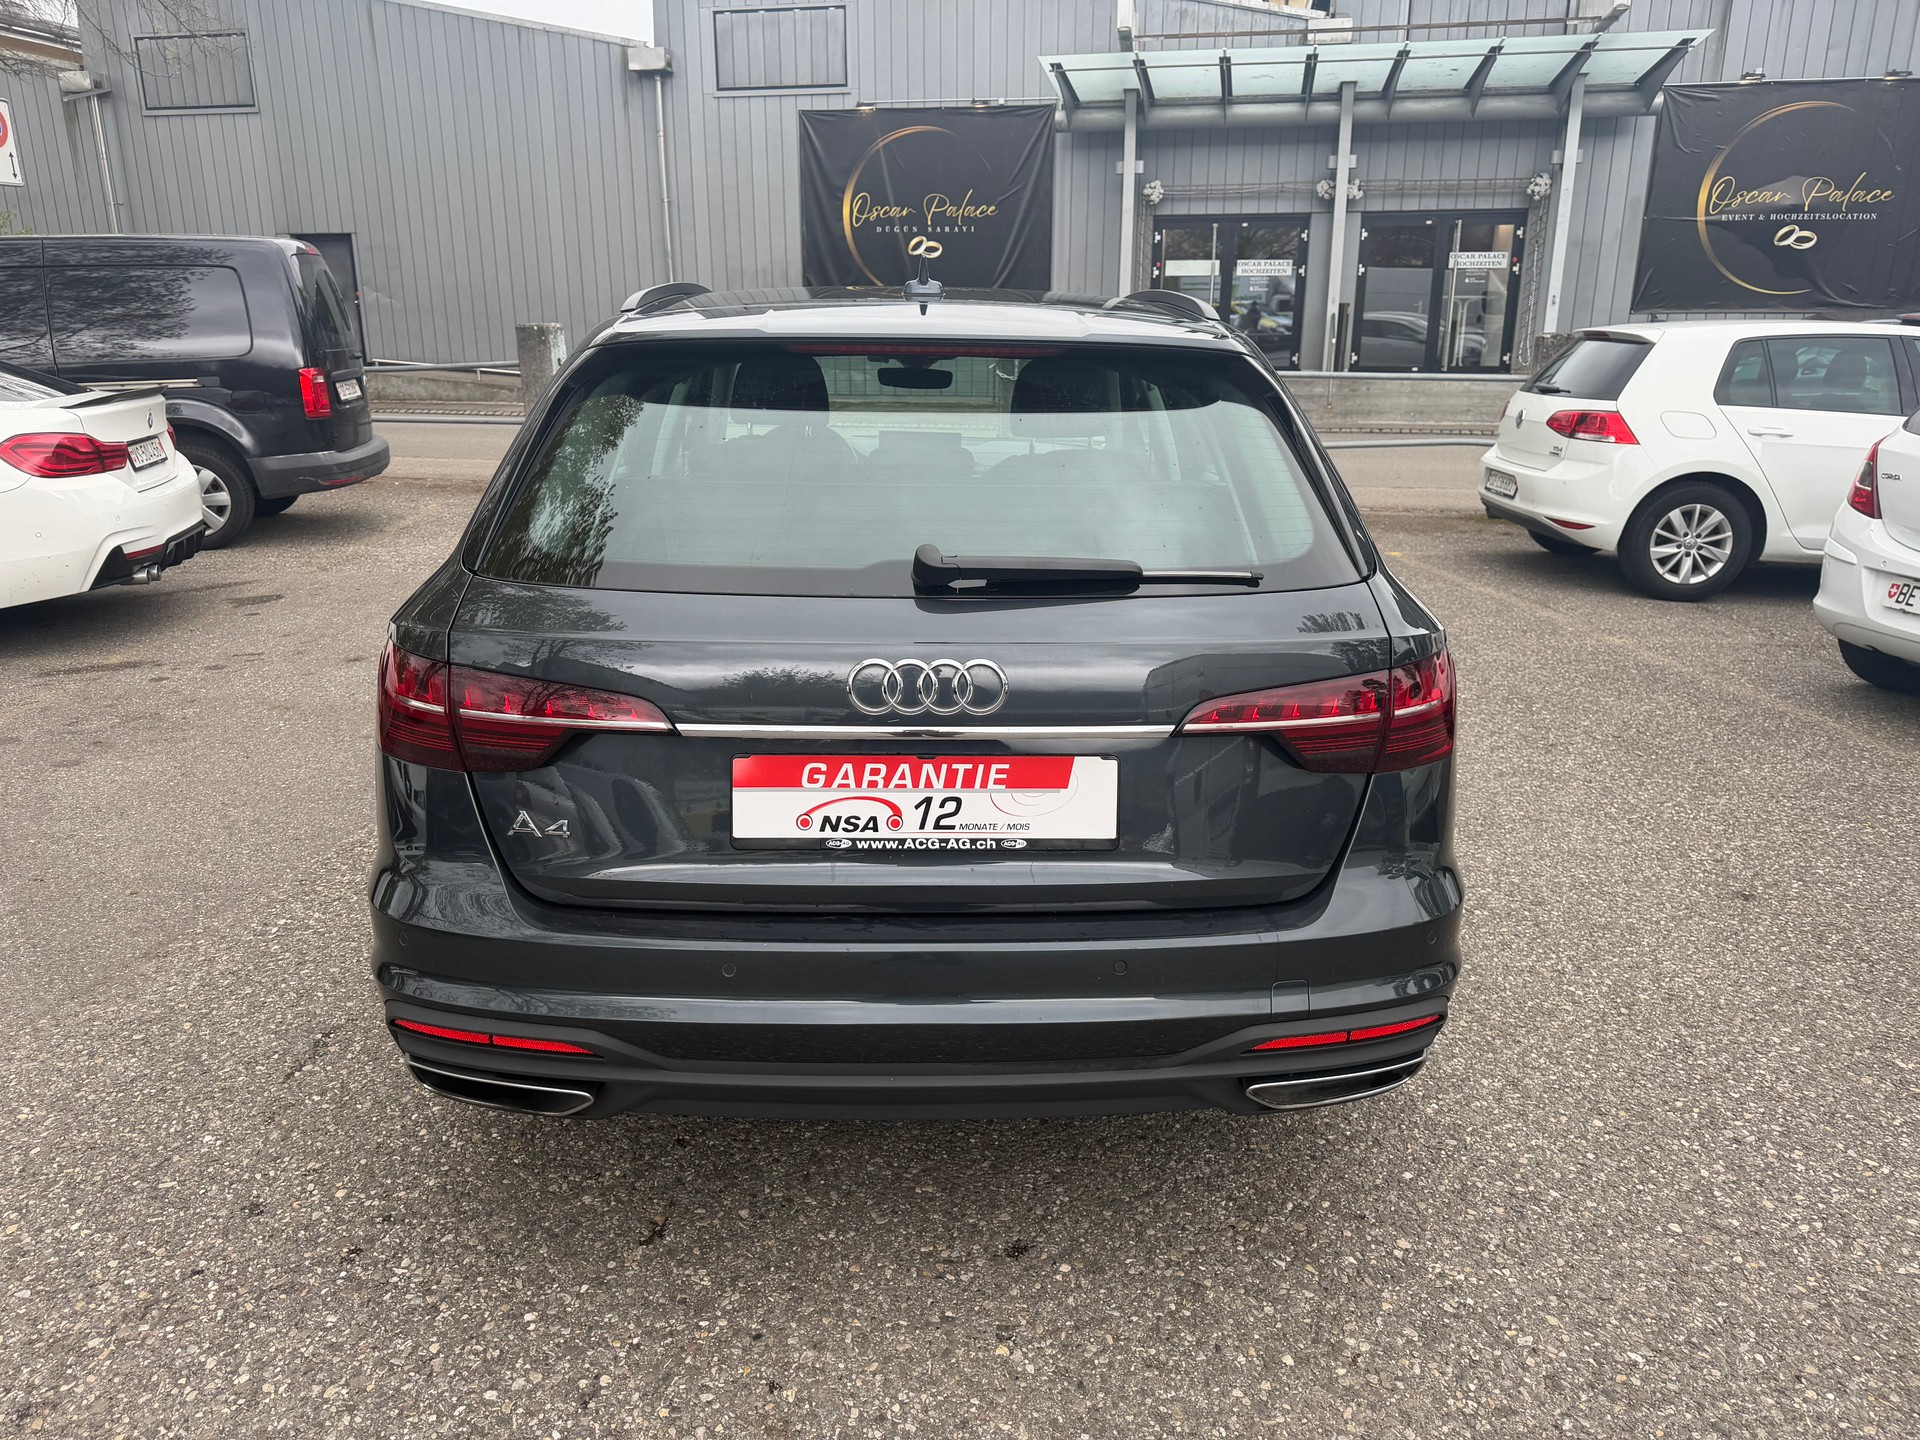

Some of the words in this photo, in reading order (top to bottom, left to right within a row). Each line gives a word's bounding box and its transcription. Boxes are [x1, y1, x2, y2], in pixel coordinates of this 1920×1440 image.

[1709, 176, 1792, 214] Oscar
[1802, 171, 1895, 212] Palace
[852, 192, 916, 227] Oscar
[923, 189, 998, 226] Palace
[1721, 213, 1755, 221] EVENT
[1758, 213, 1766, 221] &
[1770, 212, 1878, 221] HOCHZEITSLOCATION
[928, 225, 976, 233] SARAYI
[1895, 583, 1920, 607] BE
[801, 763, 1010, 789] GARANTIE
[507, 810, 571, 838] A4
[819, 815, 879, 833] NSA
[914, 796, 963, 830] 12
[958, 823, 998, 831] MONATE
[1006, 823, 1031, 831] MOIS
[856, 838, 996, 849] www.ACG-AG.ch
